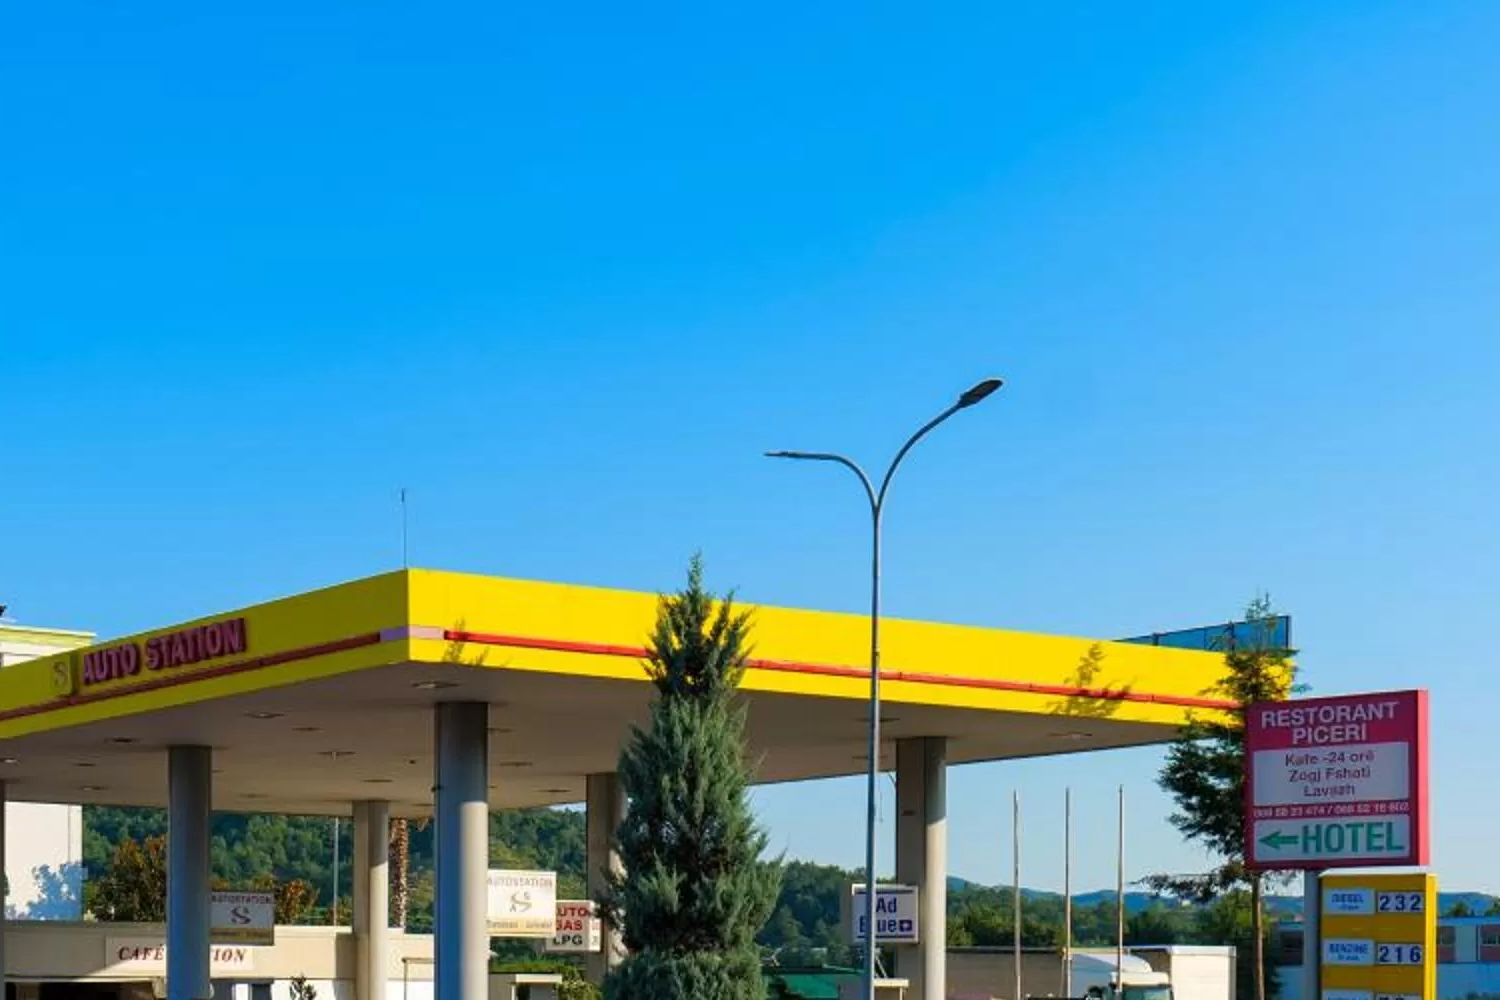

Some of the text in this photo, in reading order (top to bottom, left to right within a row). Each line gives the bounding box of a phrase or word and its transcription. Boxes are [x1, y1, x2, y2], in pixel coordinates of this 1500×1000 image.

[83, 617, 247, 685] AUTO STATION
[1261, 701, 1398, 728] RESTORANT
[1292, 723, 1368, 745] PICERI
[1301, 822, 1406, 853] HOTEL
[557, 907, 589, 917] UTO
[876, 896, 897, 913] Ad
[1379, 895, 1421, 911] 232
[553, 934, 583, 945] LPG
[1379, 945, 1421, 963] 216
